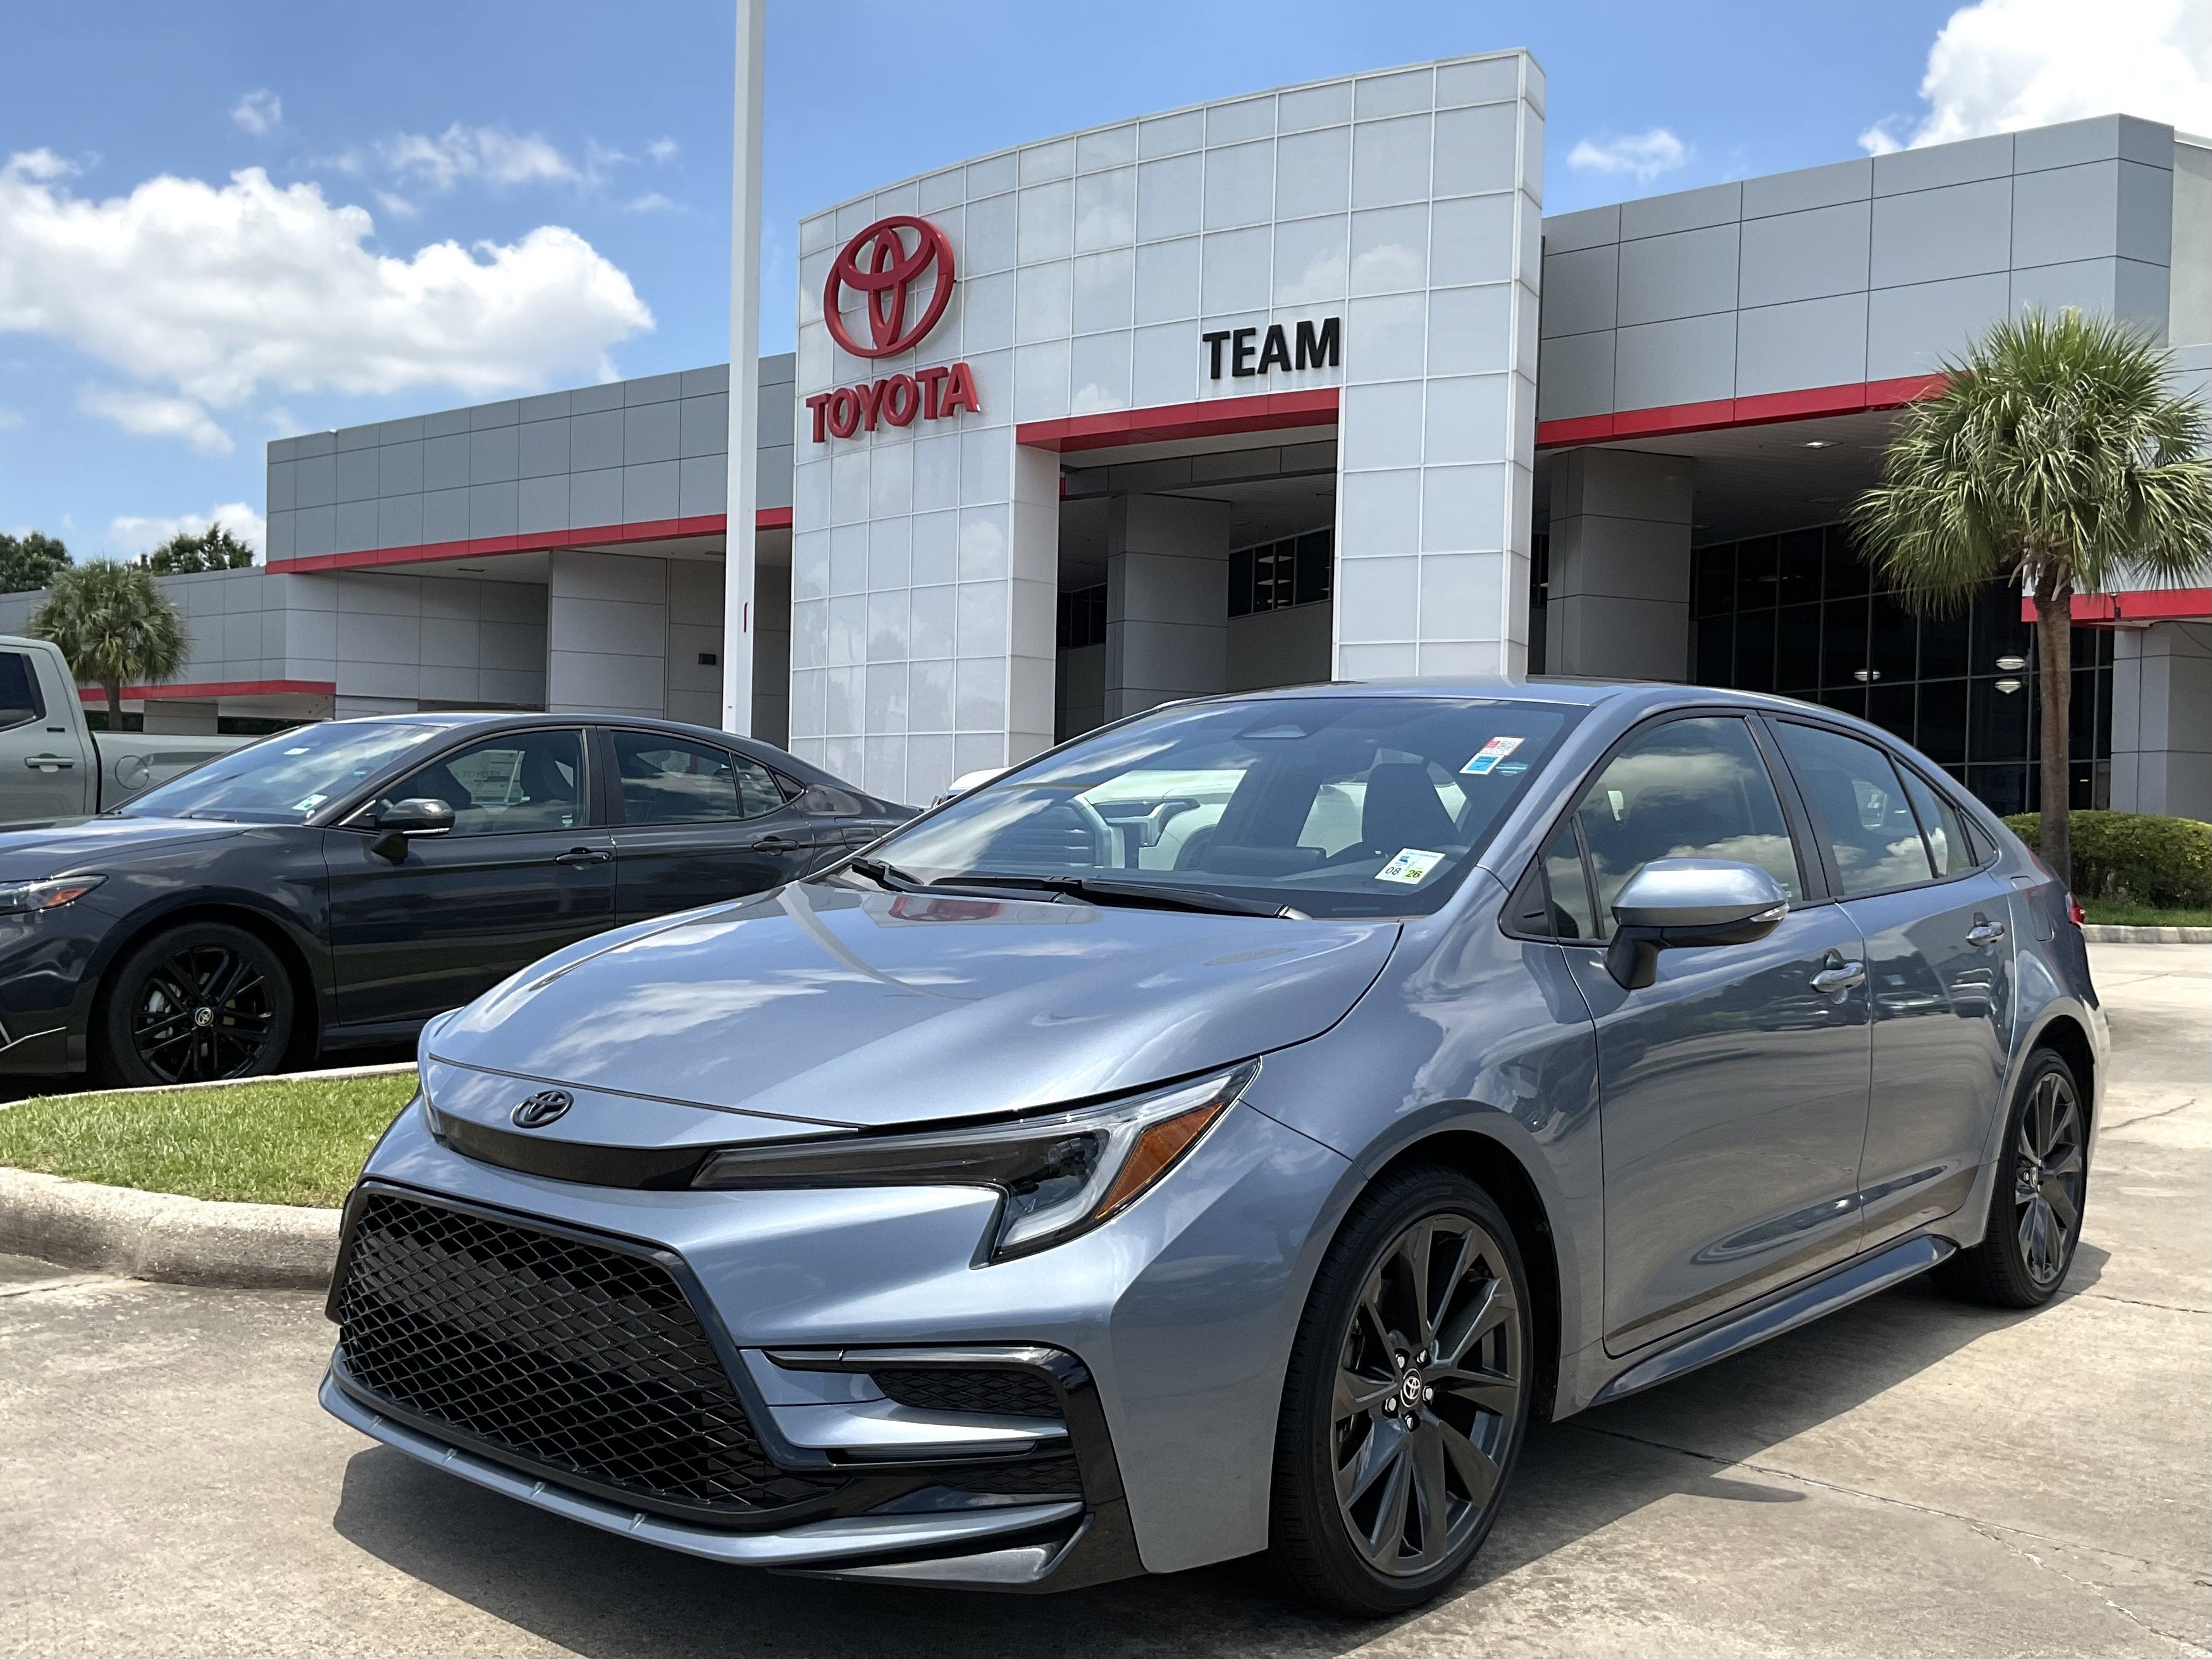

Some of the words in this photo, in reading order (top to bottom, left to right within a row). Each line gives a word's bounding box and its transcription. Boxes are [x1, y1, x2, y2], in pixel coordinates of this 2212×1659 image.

[1202, 317, 1340, 379] TEAM
[806, 362, 980, 443] TOYOTA
[1385, 867, 1402, 875] 08
[1405, 870, 1423, 878] 26
